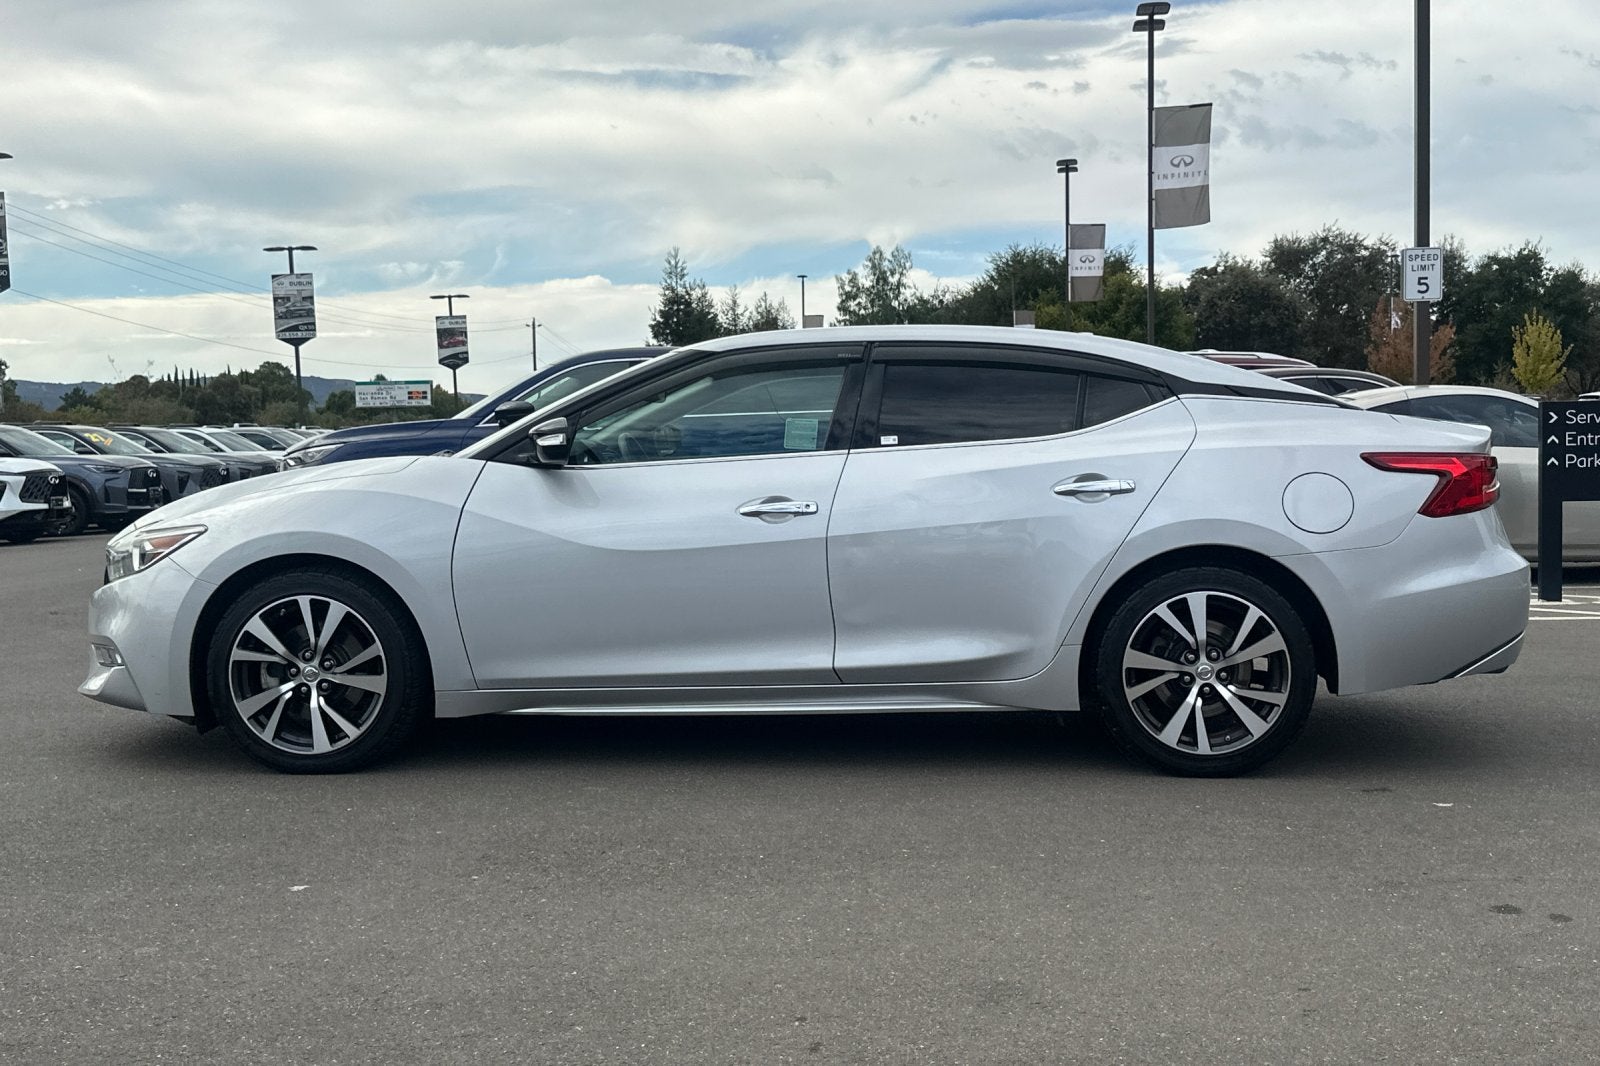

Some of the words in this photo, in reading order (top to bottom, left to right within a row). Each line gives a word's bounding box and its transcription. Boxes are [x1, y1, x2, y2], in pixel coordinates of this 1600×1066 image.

[1157, 170, 1207, 180] INFINITI
[1408, 253, 1439, 262] SPEED
[1411, 263, 1436, 272] LIMIT
[1417, 276, 1430, 294] 5
[1565, 409, 1600, 425] Serv
[1565, 431, 1600, 446] Entr
[1565, 453, 1600, 468] Park
